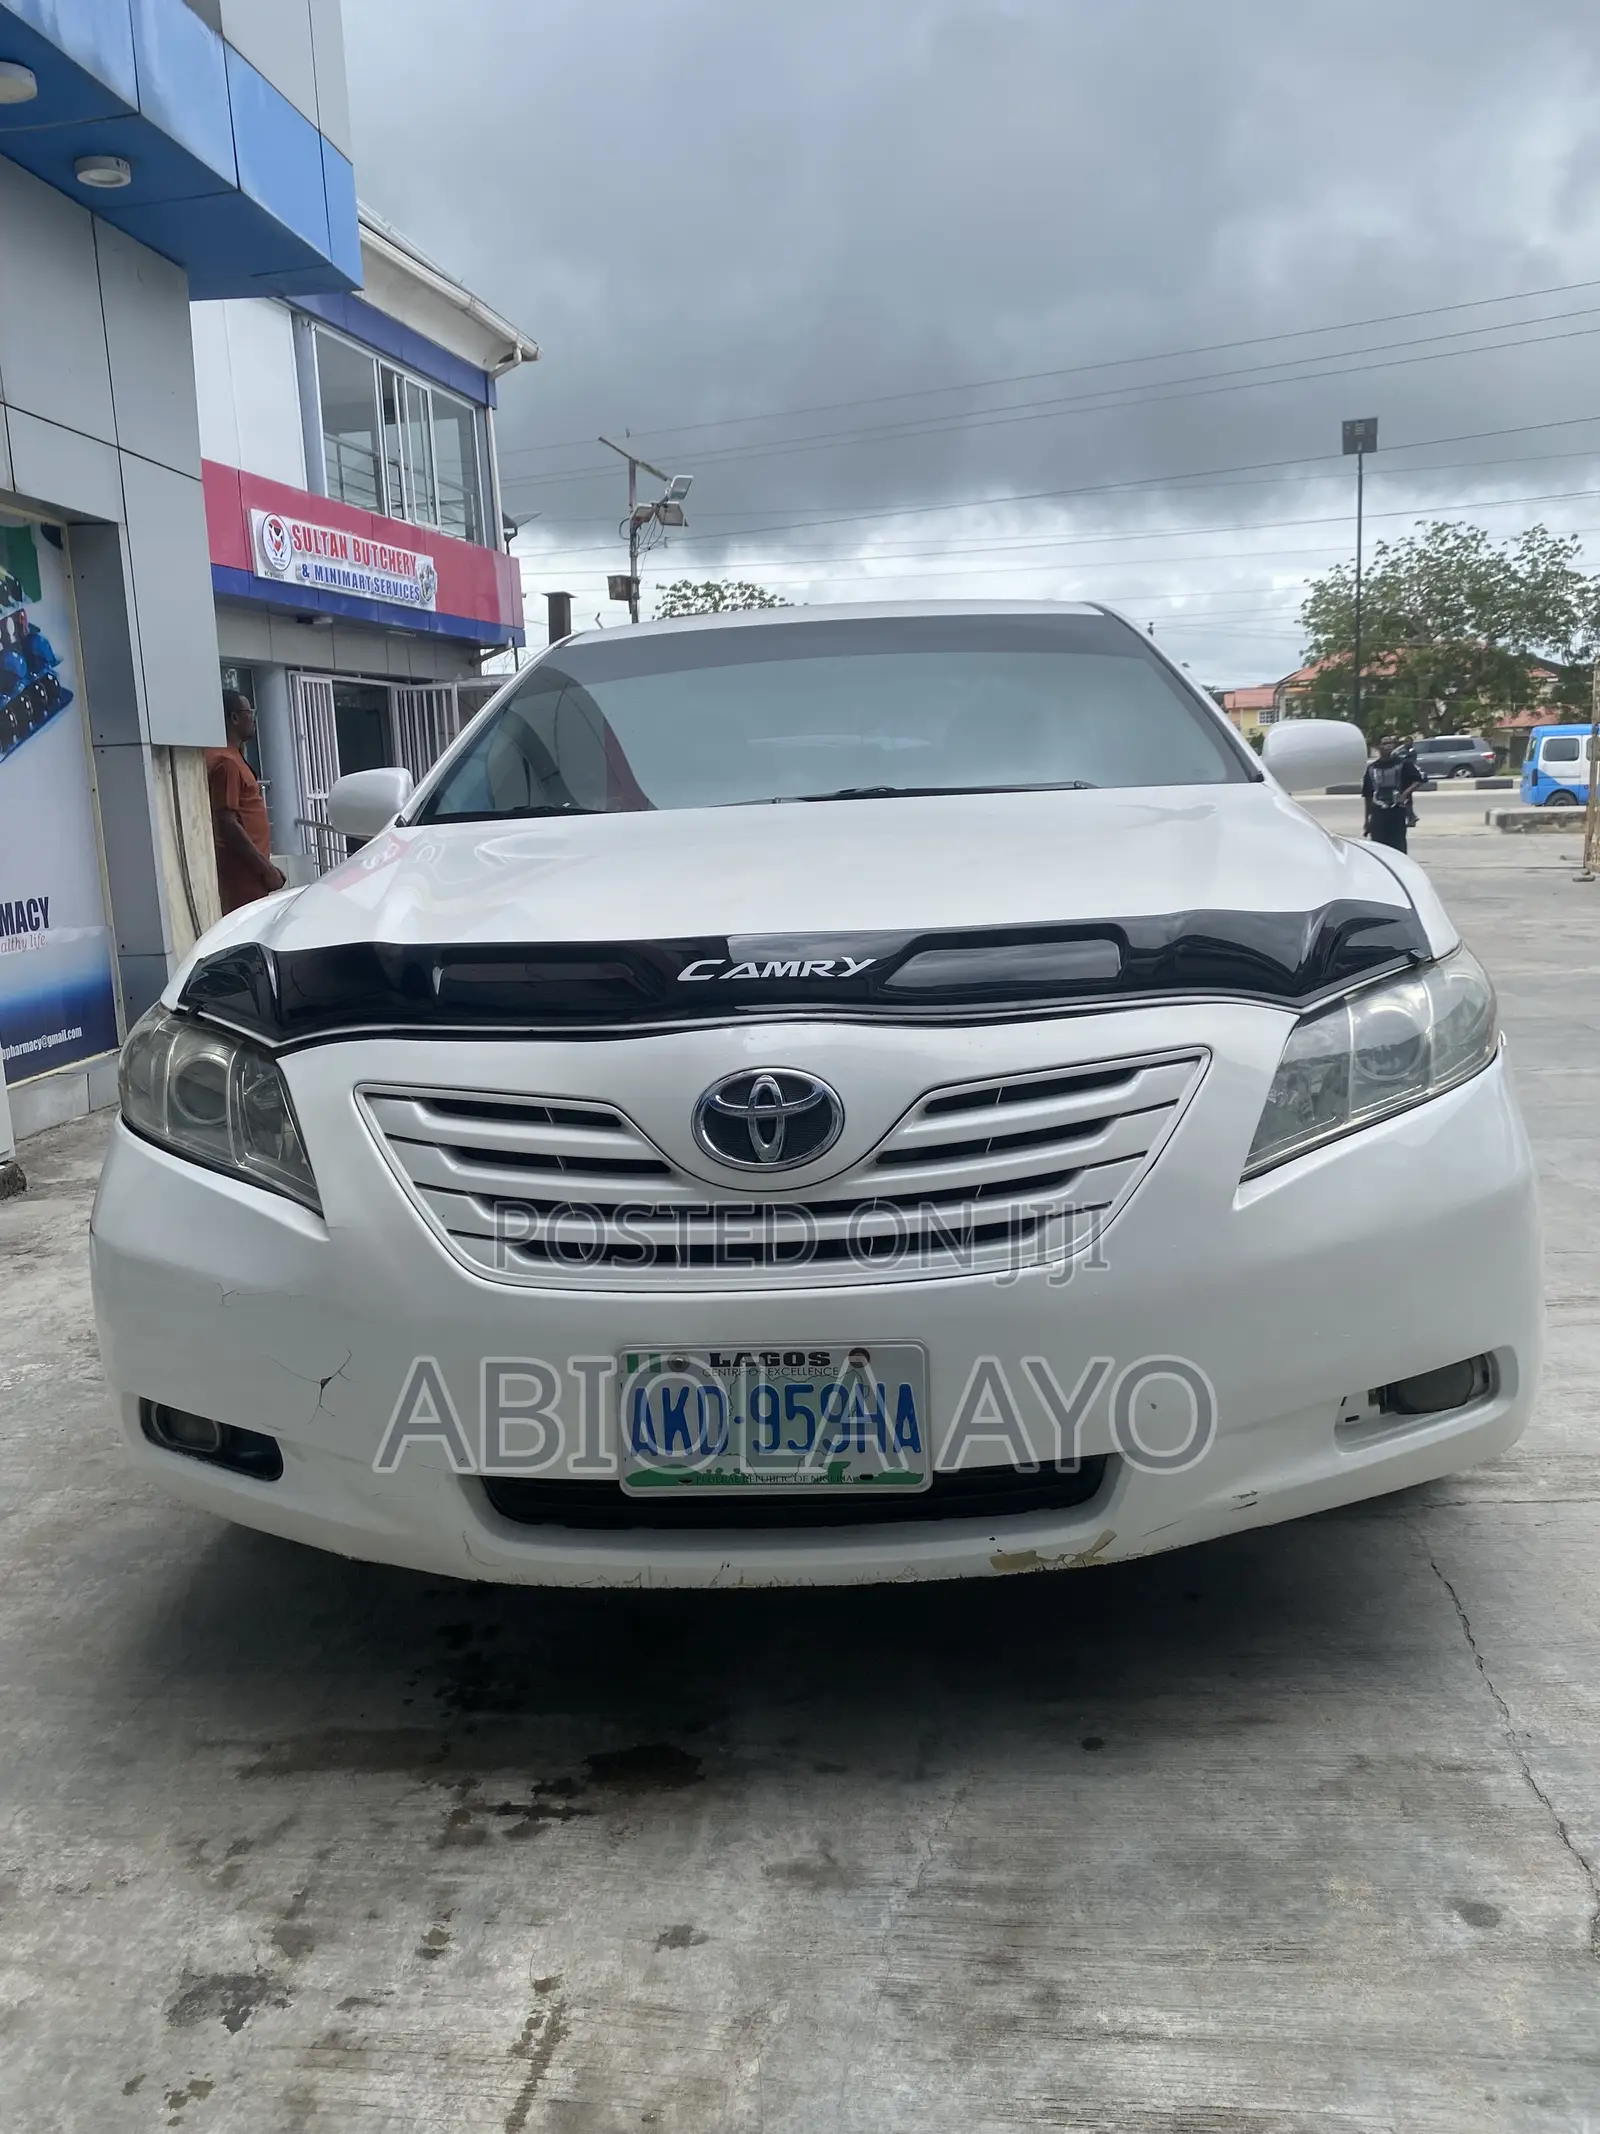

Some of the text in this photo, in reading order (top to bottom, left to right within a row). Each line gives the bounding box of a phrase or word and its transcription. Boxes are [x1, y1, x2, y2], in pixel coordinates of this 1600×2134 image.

[292, 524, 416, 576] SULTAN BUTCHERY
[302, 564, 310, 578] &
[315, 565, 371, 589] MINIMART
[373, 580, 420, 601] SERVICES
[30, 932, 46, 950] life
[677, 956, 878, 982] CAMRY
[709, 1351, 831, 1368] LAGOS
[767, 1366, 839, 1377] EXCELLENCE
